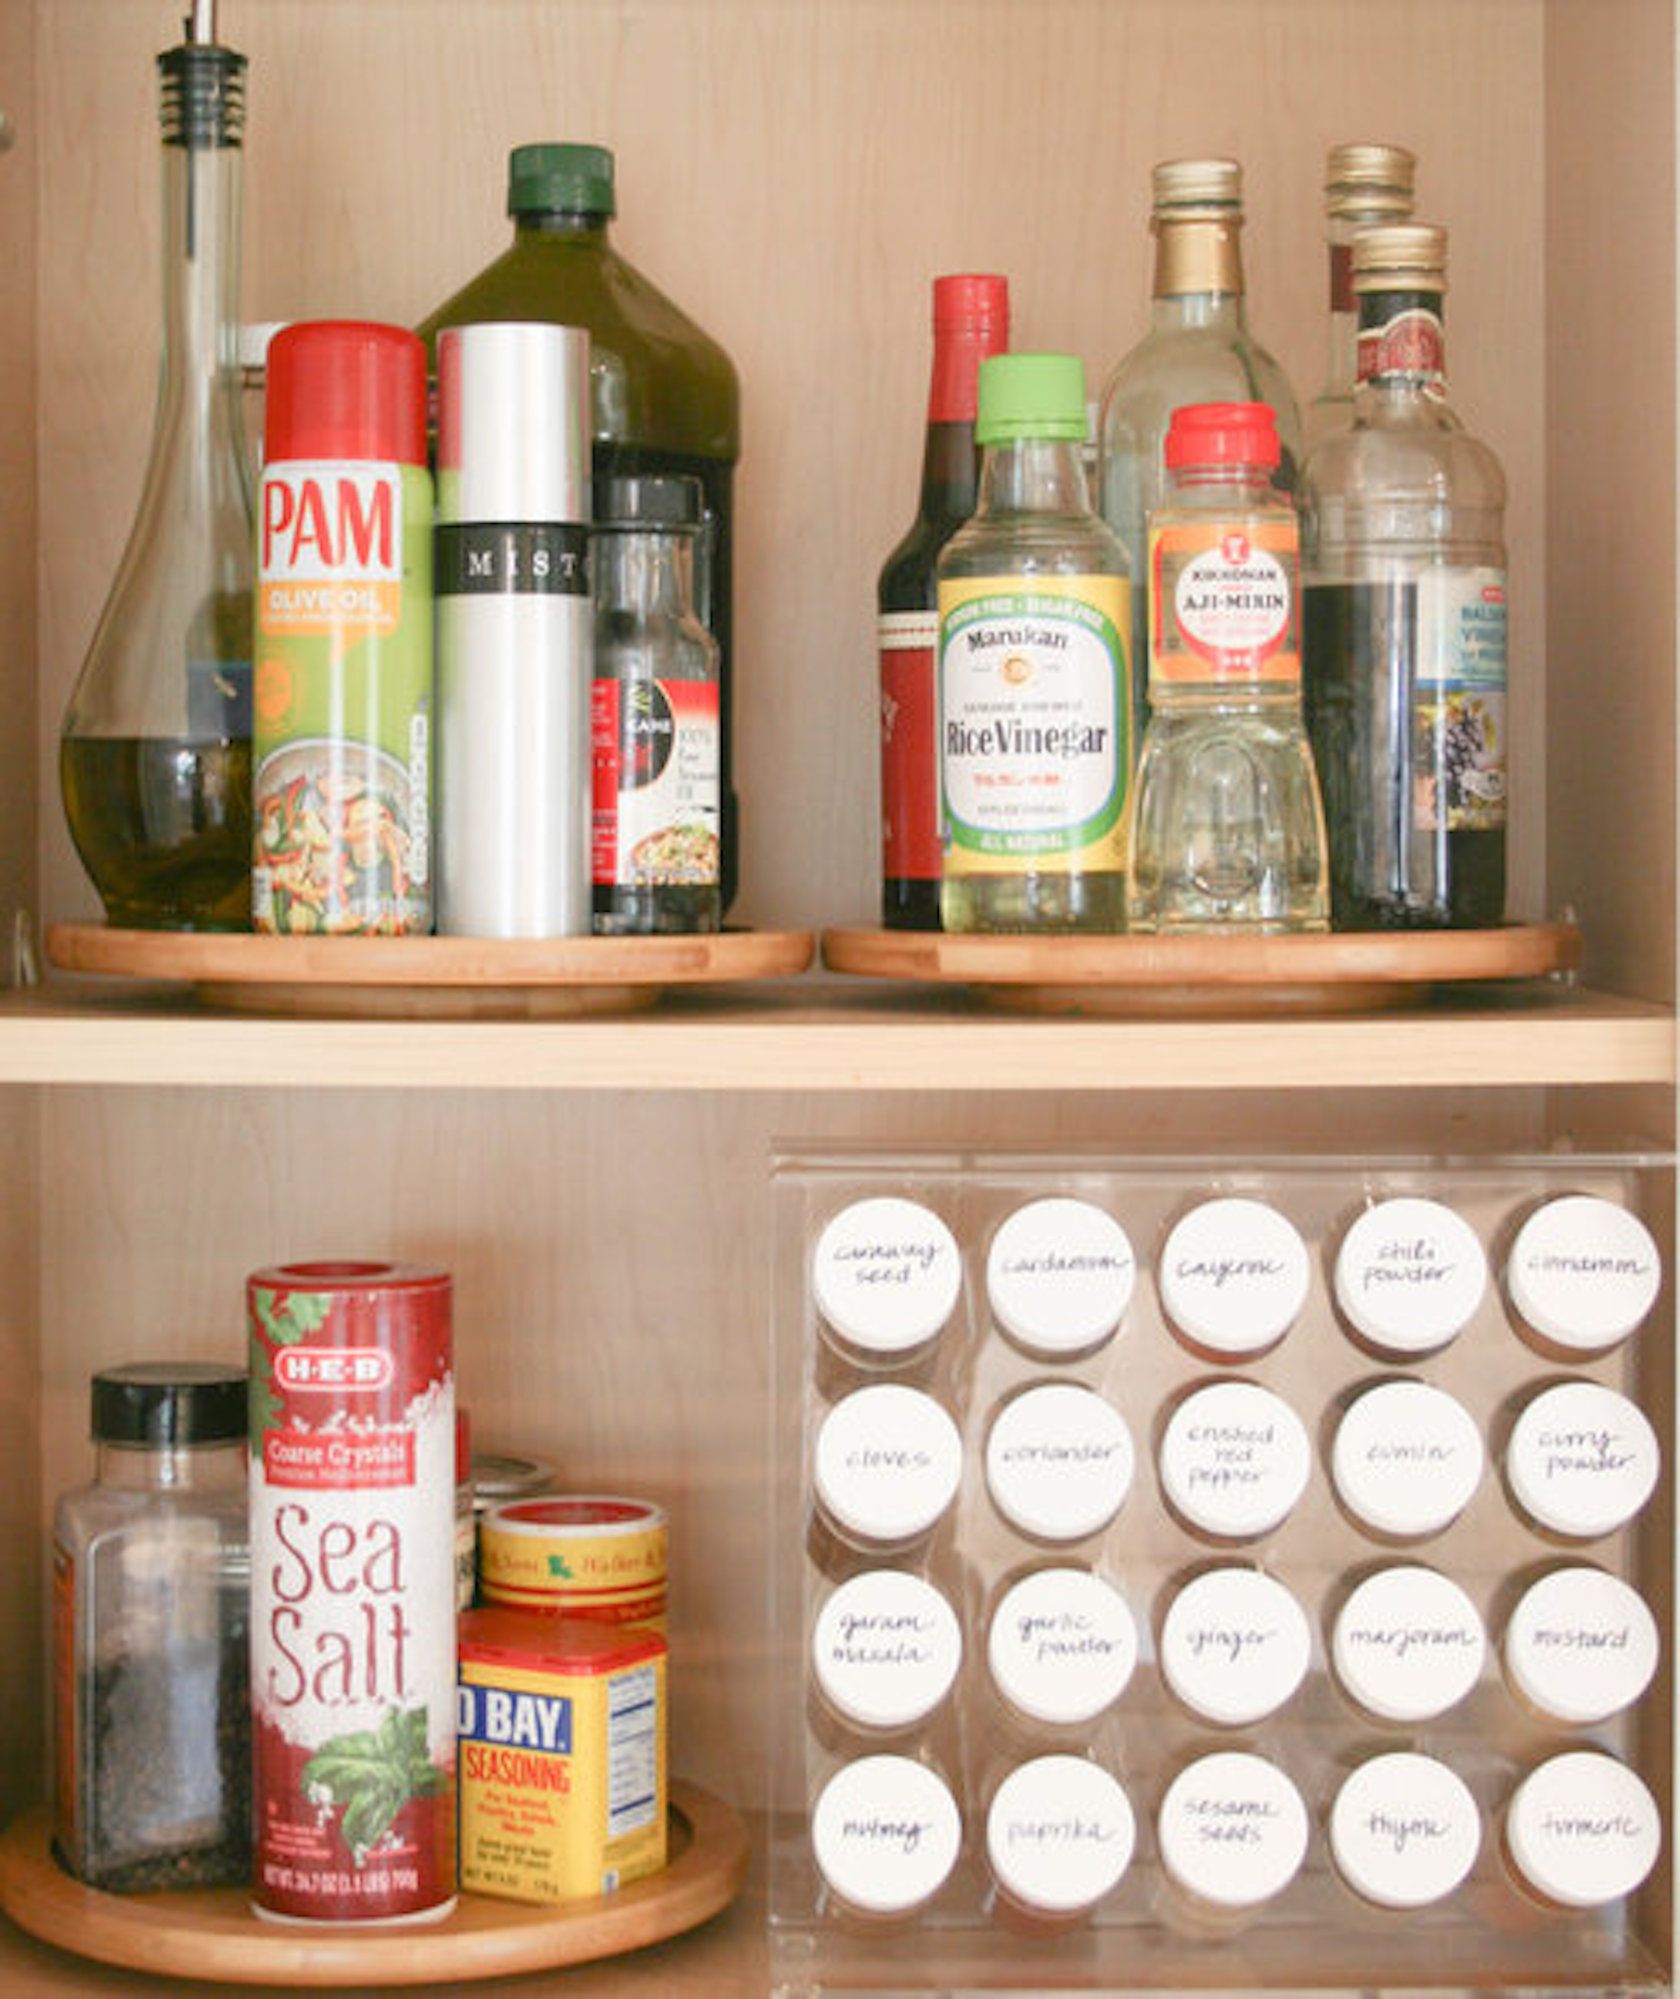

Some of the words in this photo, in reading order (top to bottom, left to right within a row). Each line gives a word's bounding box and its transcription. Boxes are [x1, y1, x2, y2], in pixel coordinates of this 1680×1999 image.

[262, 477, 392, 570] PAM
[270, 589, 330, 611] OLIVE
[341, 591, 381, 611] OIL
[1183, 594, 1284, 611] AJI-MIRIN
[967, 626, 1069, 653] Marukan
[1377, 1239, 1435, 1261] chili
[856, 1265, 912, 1285] seed
[1363, 1263, 1456, 1291] powder
[1187, 1424, 1275, 1443] crushed
[1537, 1431, 1618, 1455] curry
[268, 1440, 322, 1463] Coarse
[328, 1439, 405, 1467] Crystals
[846, 1451, 932, 1469] cloves
[1214, 1447, 1254, 1463] red
[1547, 1447, 1637, 1478] powder
[271, 1503, 407, 1603] Sea
[1186, 1627, 1279, 1662] ginger
[1350, 1626, 1478, 1657] marjoram
[1532, 1625, 1630, 1649] mustard
[268, 1602, 411, 1708] Salt
[466, 1747, 571, 1795] SEASONING
[1184, 1799, 1280, 1816] sesame
[842, 1820, 934, 1854] nutmeg
[1007, 1816, 1118, 1846] paprika
[1197, 1822, 1262, 1843] seeds
[1367, 1809, 1452, 1853] thyme
[1540, 1814, 1642, 1837] turmeric
